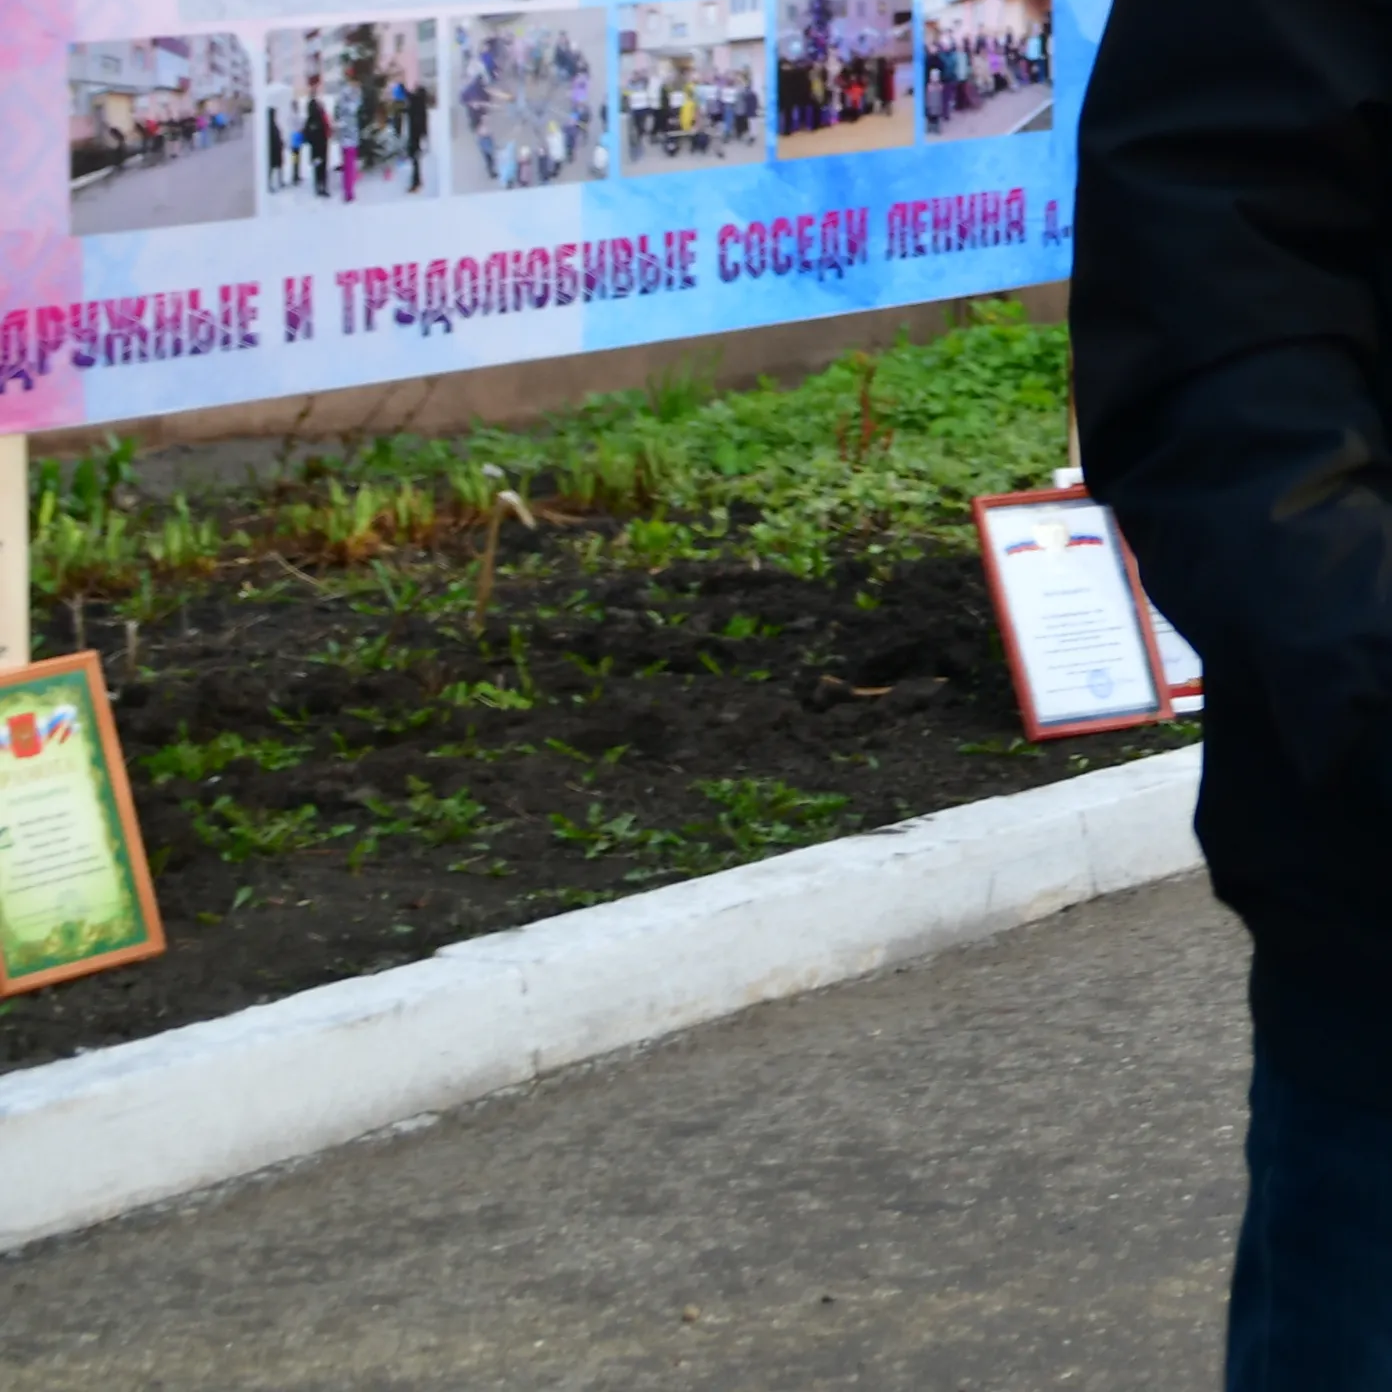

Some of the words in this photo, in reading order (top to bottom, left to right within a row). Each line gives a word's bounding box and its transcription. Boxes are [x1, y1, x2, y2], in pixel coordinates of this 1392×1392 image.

[0, 280, 260, 395] ДРУЖНЫЕ
[283, 274, 314, 343] И
[334, 228, 699, 337] ТРУДОЛЮБИВЫЕ
[717, 206, 869, 284] СОСЕДИ
[885, 186, 1027, 261] ЛЕНИНА
